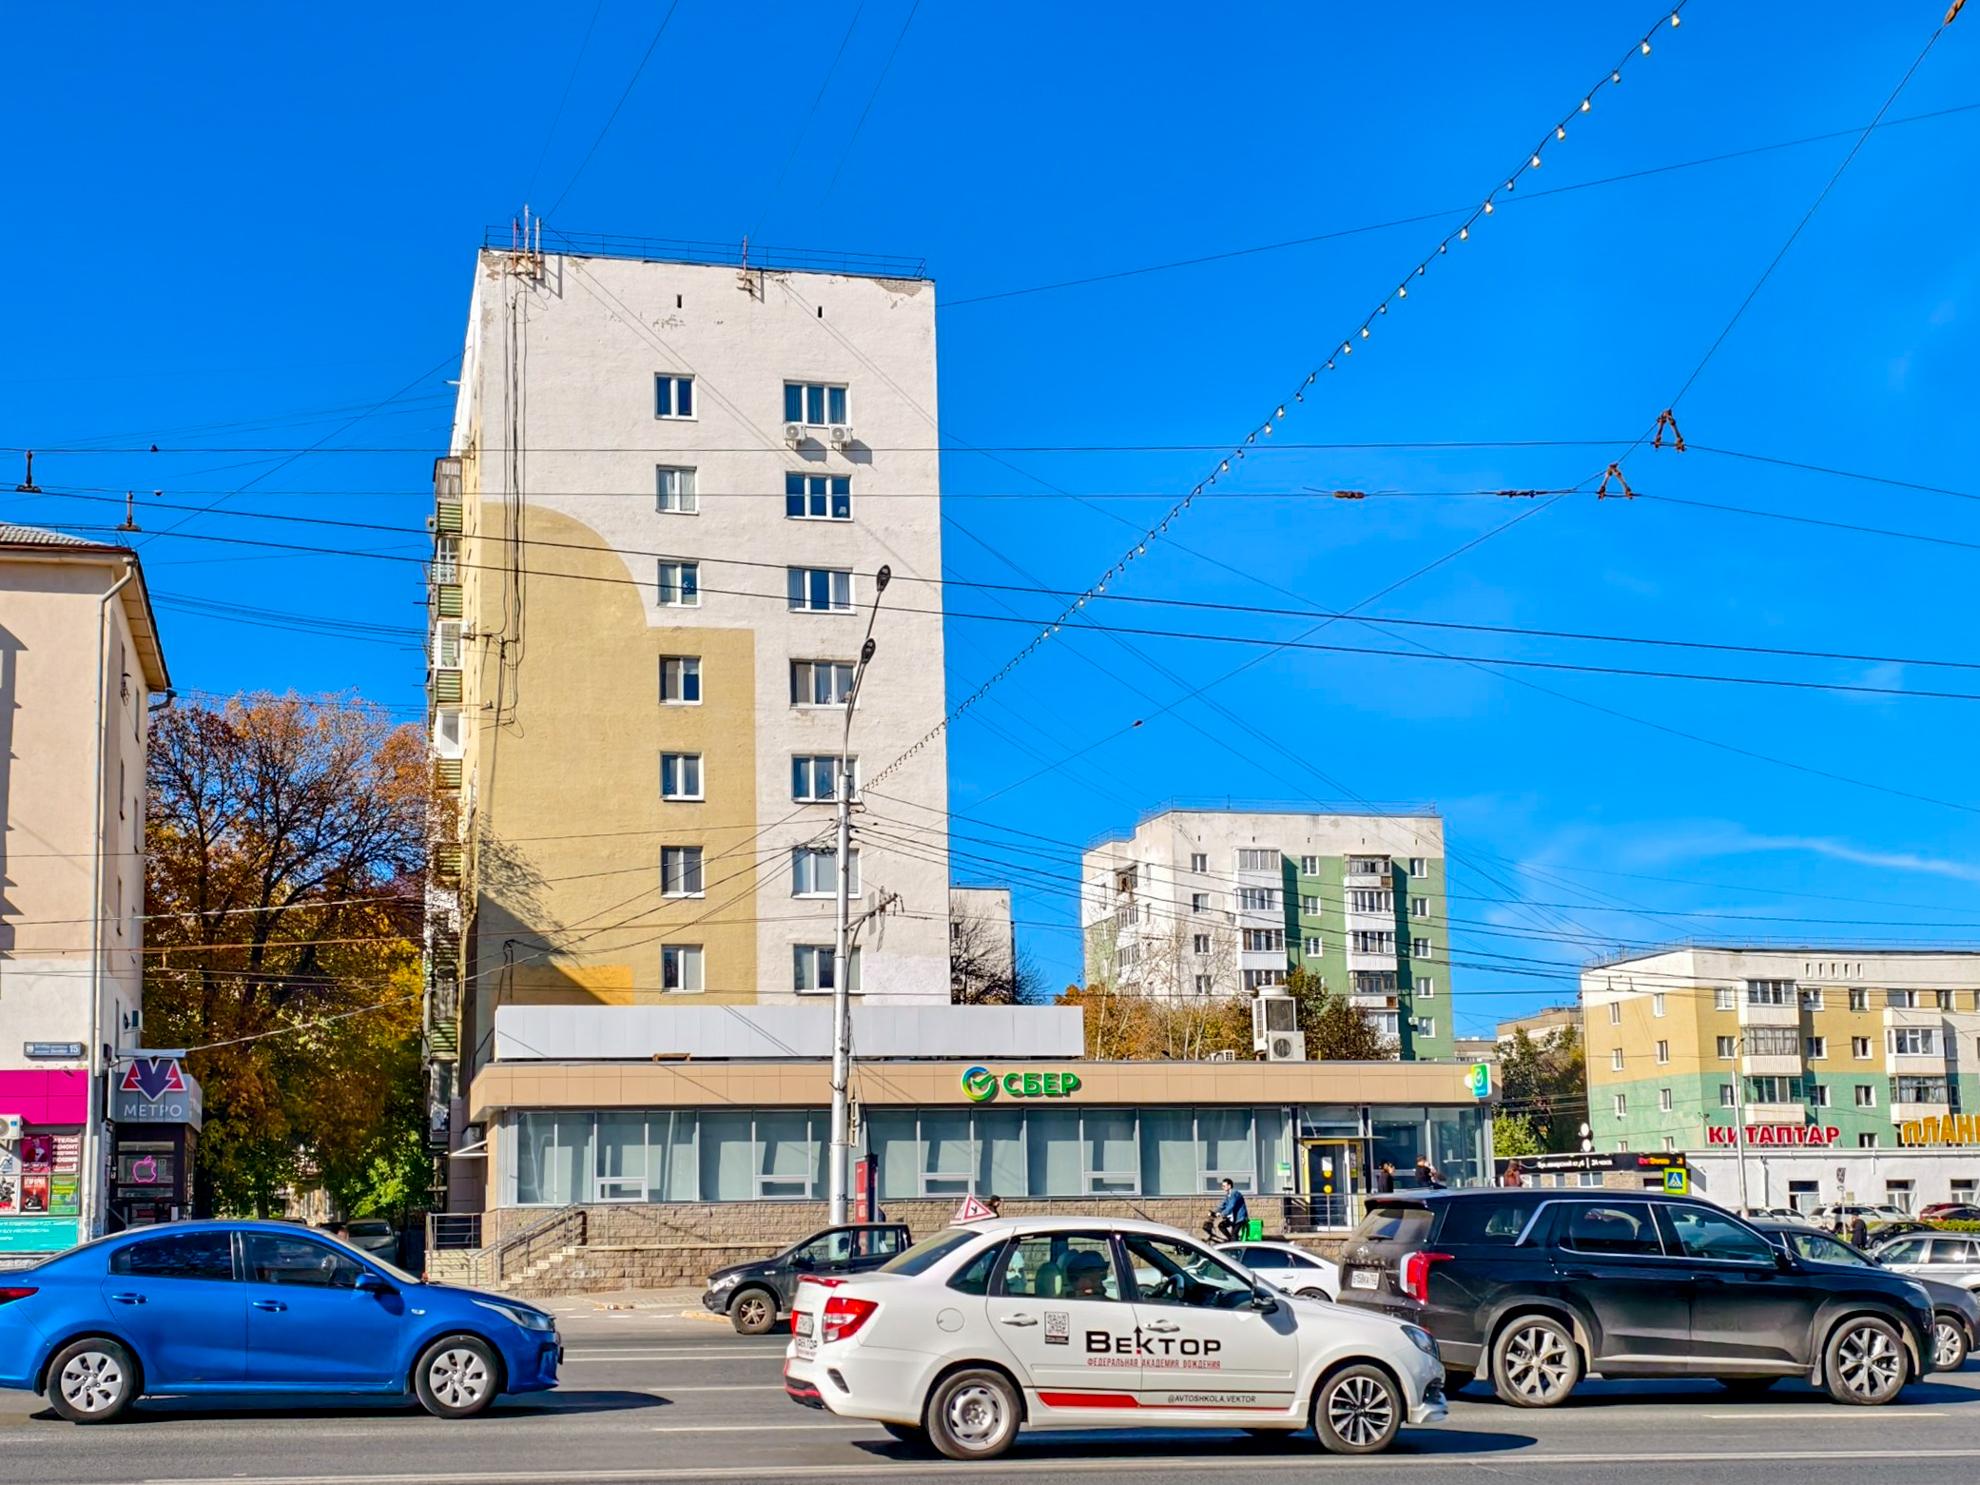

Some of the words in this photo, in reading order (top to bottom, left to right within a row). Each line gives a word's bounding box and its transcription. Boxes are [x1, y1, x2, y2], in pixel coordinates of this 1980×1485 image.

[1002, 1072, 1081, 1096] СБЕР
[123, 1104, 183, 1117] МЕТРО
[1707, 1125, 1840, 1145] КИТАПТАР
[1087, 1358, 1138, 1368] ФЕДЕРАЛЬНАЯ
[1141, 1360, 1180, 1369] АКАДЕМИЯ
[1183, 1360, 1221, 1369] ВОЖДЕНИЯ
